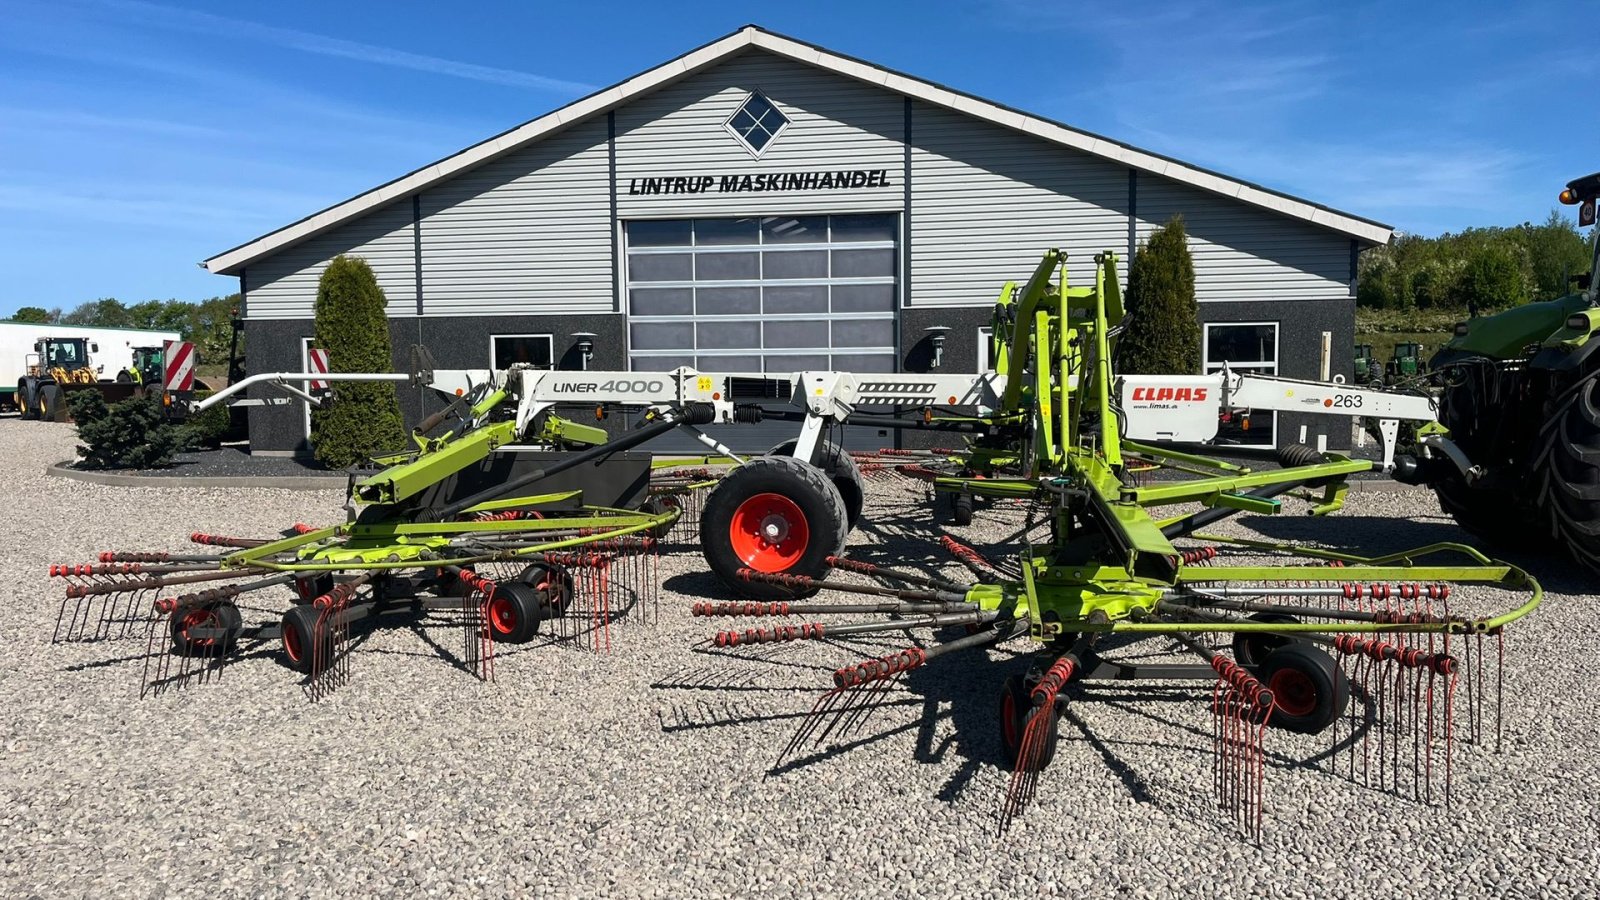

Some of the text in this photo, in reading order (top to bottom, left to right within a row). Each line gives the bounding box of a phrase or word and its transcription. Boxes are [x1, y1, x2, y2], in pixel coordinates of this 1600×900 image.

[629, 170, 891, 195] LINTRUP MASKINHANDEL
[553, 380, 663, 393] LINER 4000
[1132, 387, 1207, 401] CLAAS
[1334, 394, 1363, 408] 263
